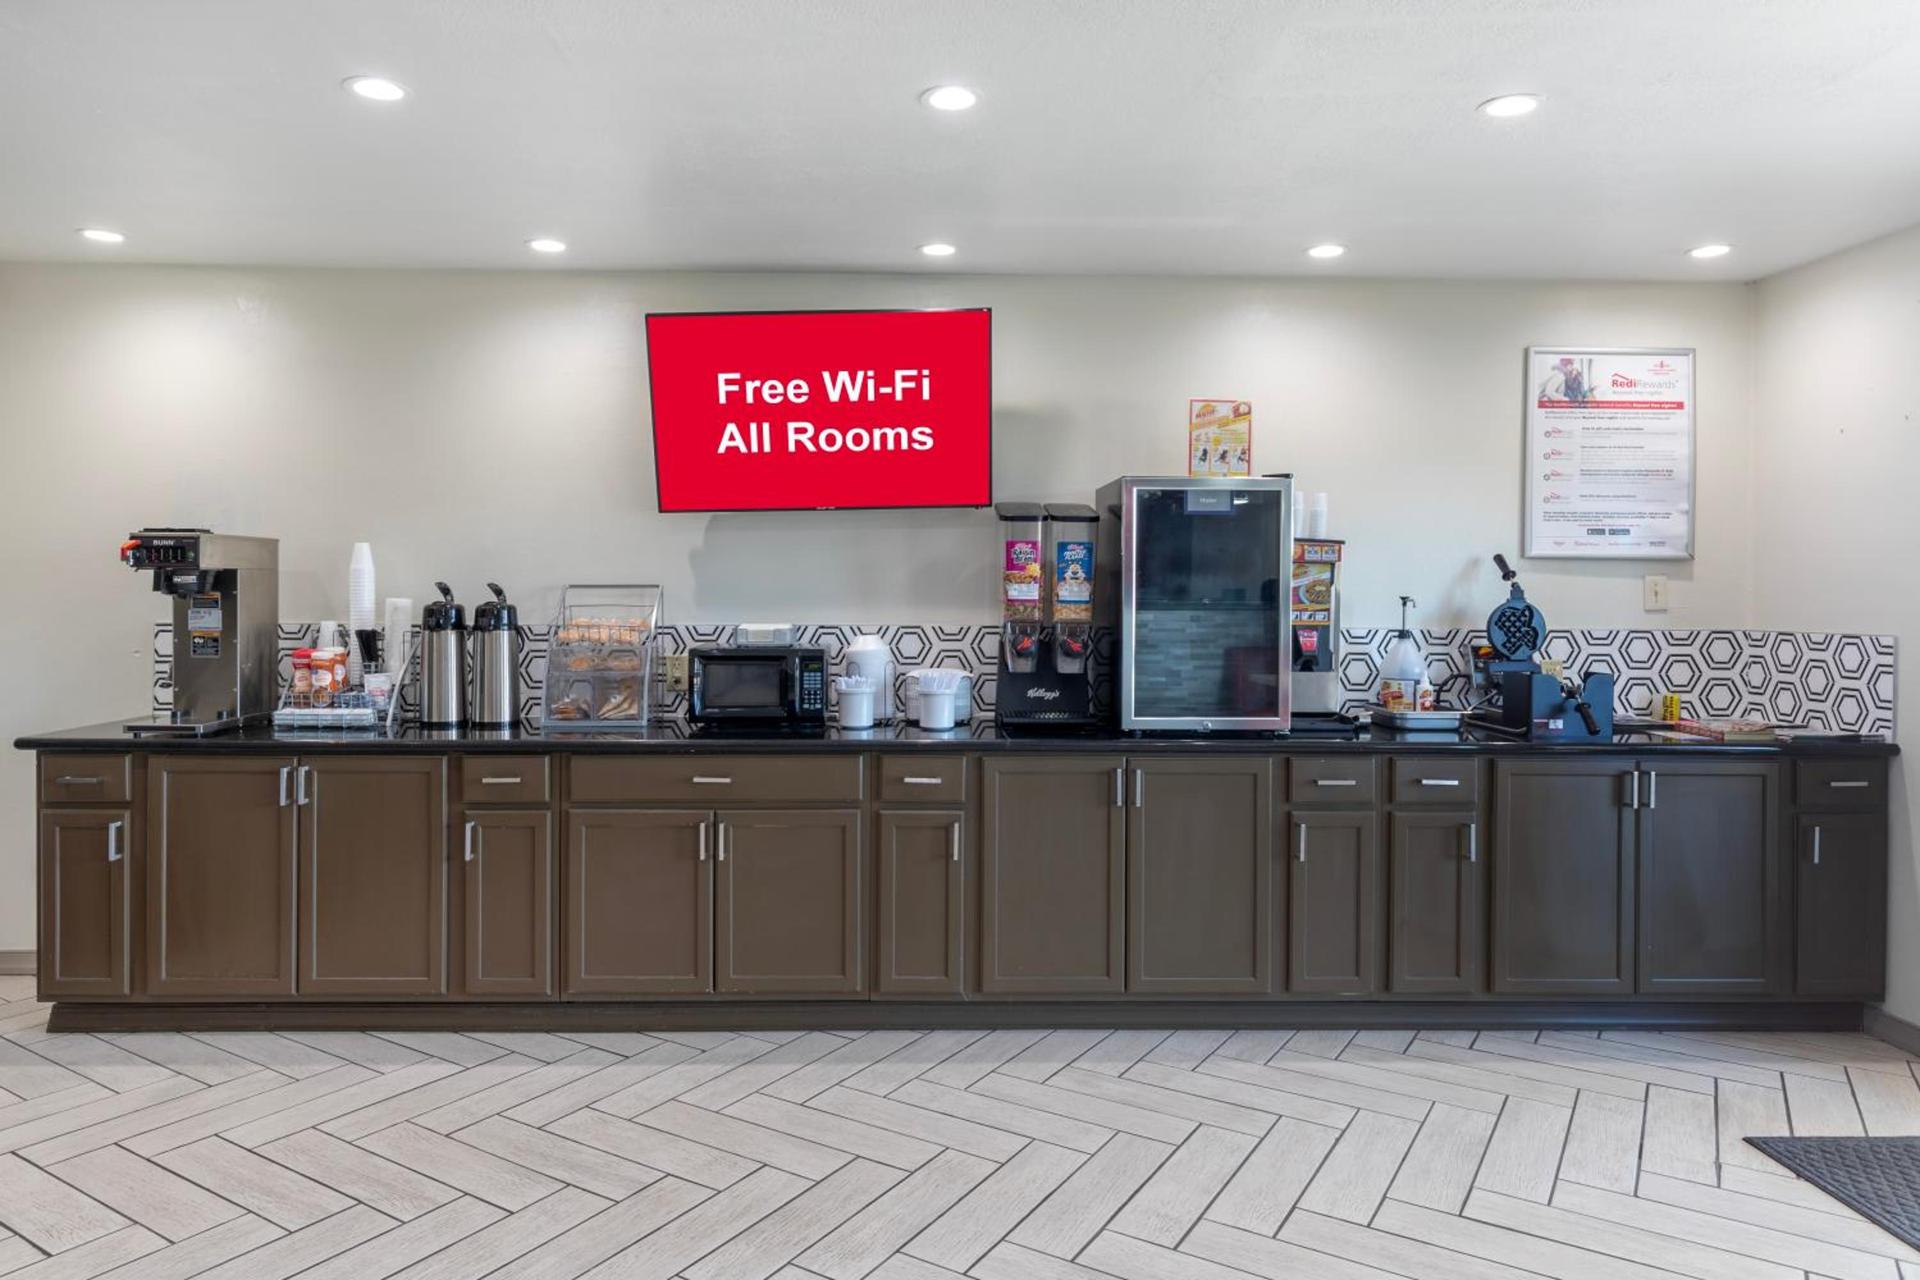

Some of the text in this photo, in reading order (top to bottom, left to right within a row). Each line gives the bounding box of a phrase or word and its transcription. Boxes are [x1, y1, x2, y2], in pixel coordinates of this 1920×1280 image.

[716, 369, 931, 405] Free Wi-Fi
[716, 421, 934, 454] All Rooms
[1026, 687, 1060, 700] Kellogg's
